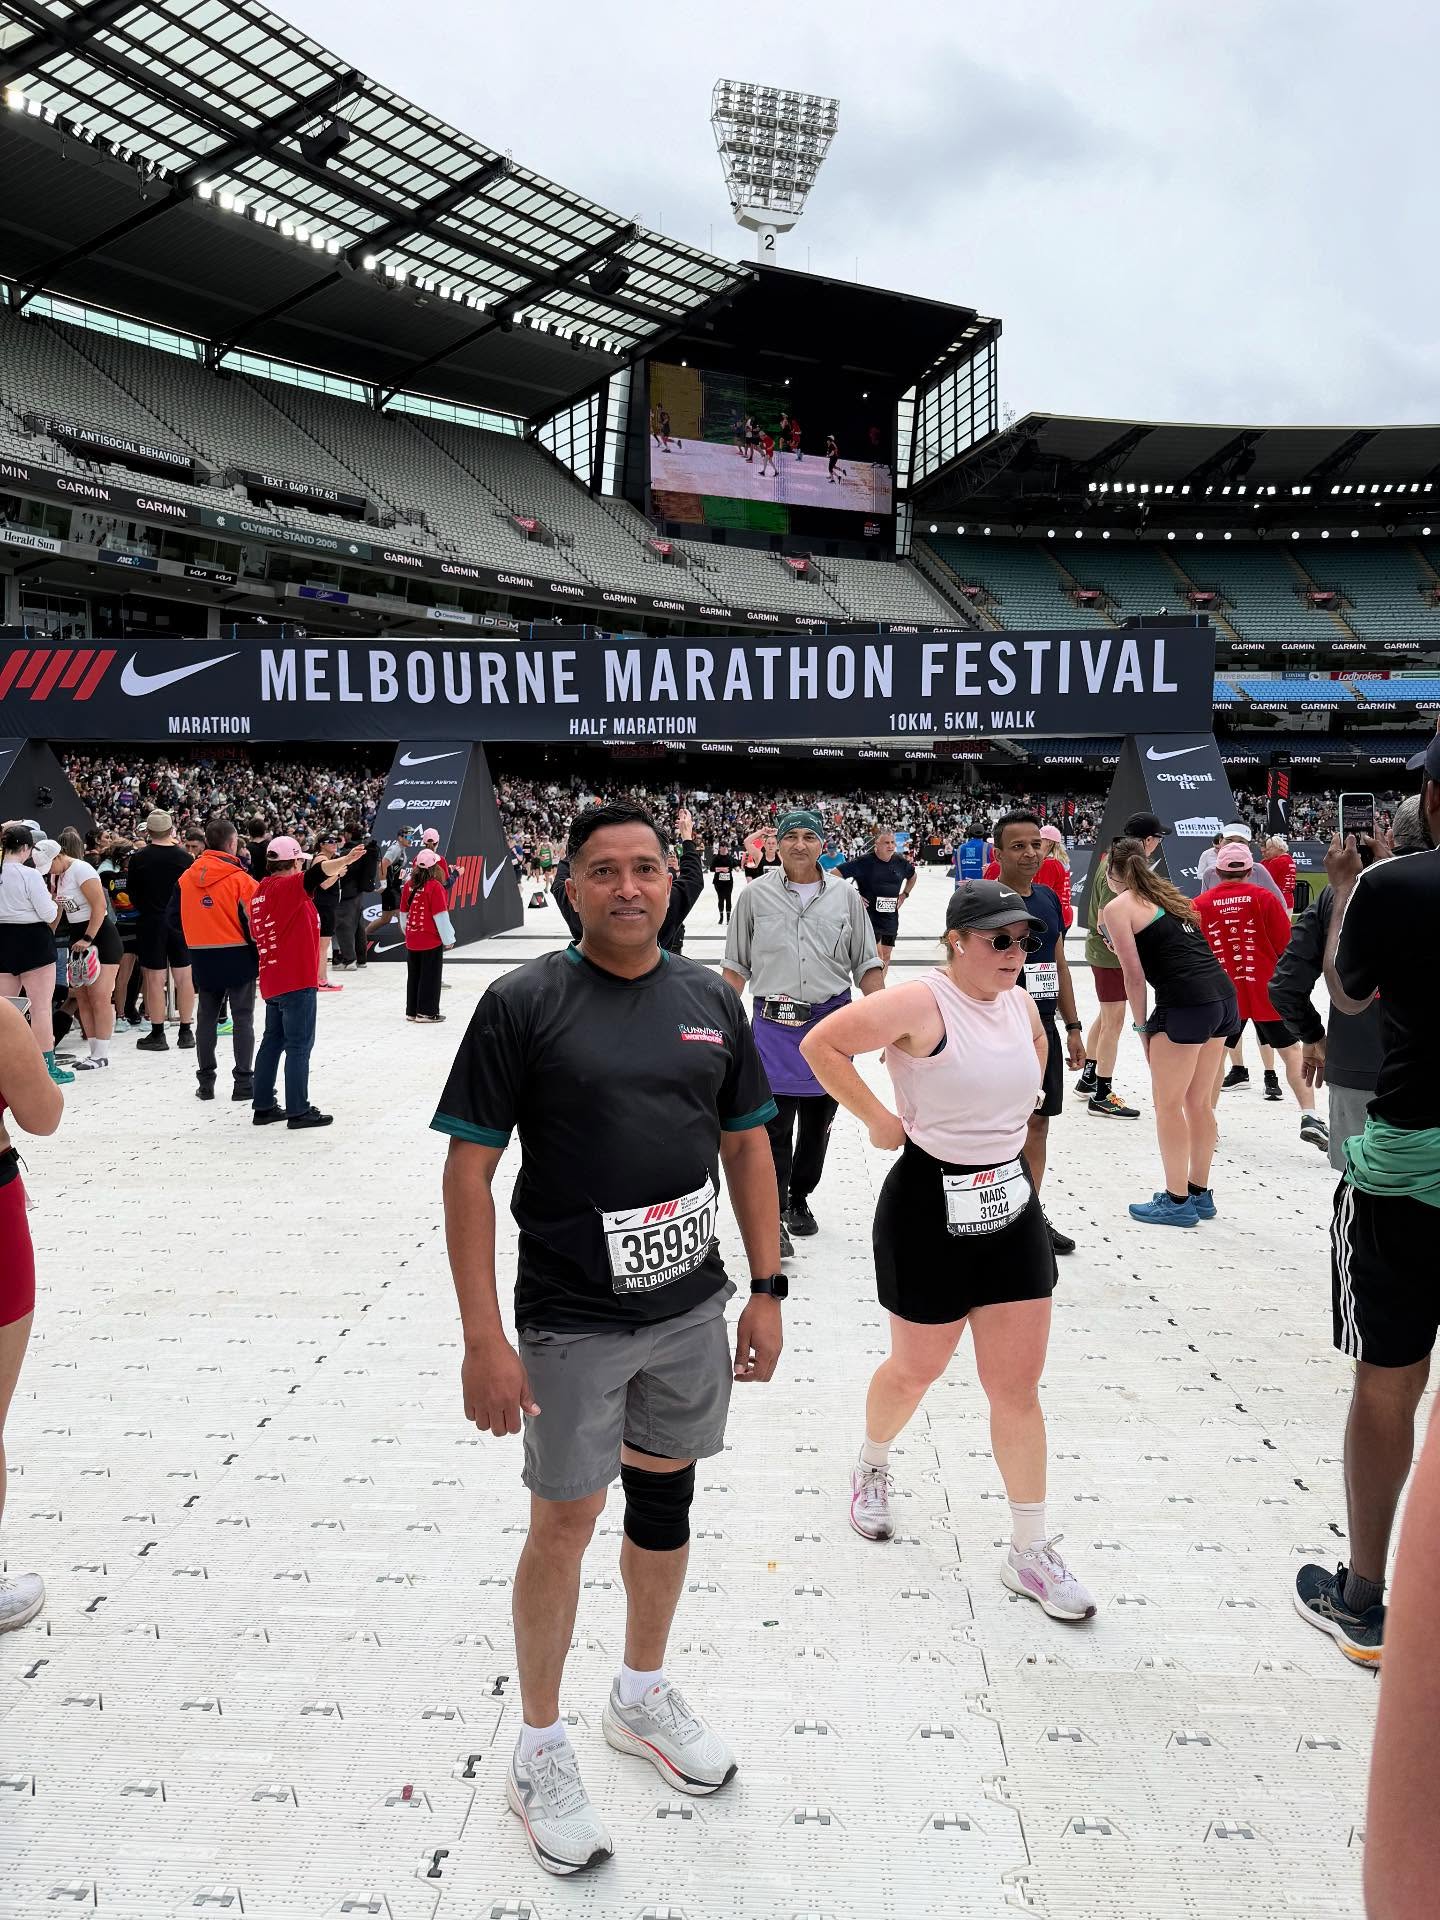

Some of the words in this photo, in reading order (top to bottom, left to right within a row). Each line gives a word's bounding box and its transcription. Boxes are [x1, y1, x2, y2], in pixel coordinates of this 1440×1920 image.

[764, 234, 775, 251] 2
[80, 429, 137, 453] ANTISOCIAL
[140, 445, 191, 467] BEHAVIOUR
[262, 475, 283, 488] TEXT
[289, 482, 308, 494] 0409
[310, 486, 324, 497] 117
[324, 489, 338, 500] 621
[4, 530, 36, 547] Herald
[37, 535, 55, 550] Sun
[240, 521, 282, 538] OLYMPIC
[283, 531, 315, 545] STAND
[315, 537, 338, 549] 2006
[117, 556, 133, 565] ANZ
[260, 649, 579, 704] MELBOURNE
[604, 644, 893, 702] MARATHON
[921, 639, 1178, 697] FESTIVAL
[1338, 671, 1383, 681] Ladbrokes
[168, 716, 250, 734] MARATHON
[569, 717, 608, 735] HALF
[614, 716, 697, 735] MARATHON
[889, 713, 938, 732] 10KM,
[944, 711, 984, 731] 5KM,
[990, 710, 1036, 729] WALK
[407, 799, 451, 807] PROTEIN
[1178, 823, 1221, 831] CHEMIST
[1213, 895, 1252, 907] VOLUNTEER
[979, 1186, 1007, 1204] MADS
[980, 1201, 1009, 1219] 31244
[957, 1217, 1007, 1233] MELBOURNE
[621, 1207, 711, 1274] 35930
[625, 1261, 691, 1289] MELBOURNE
